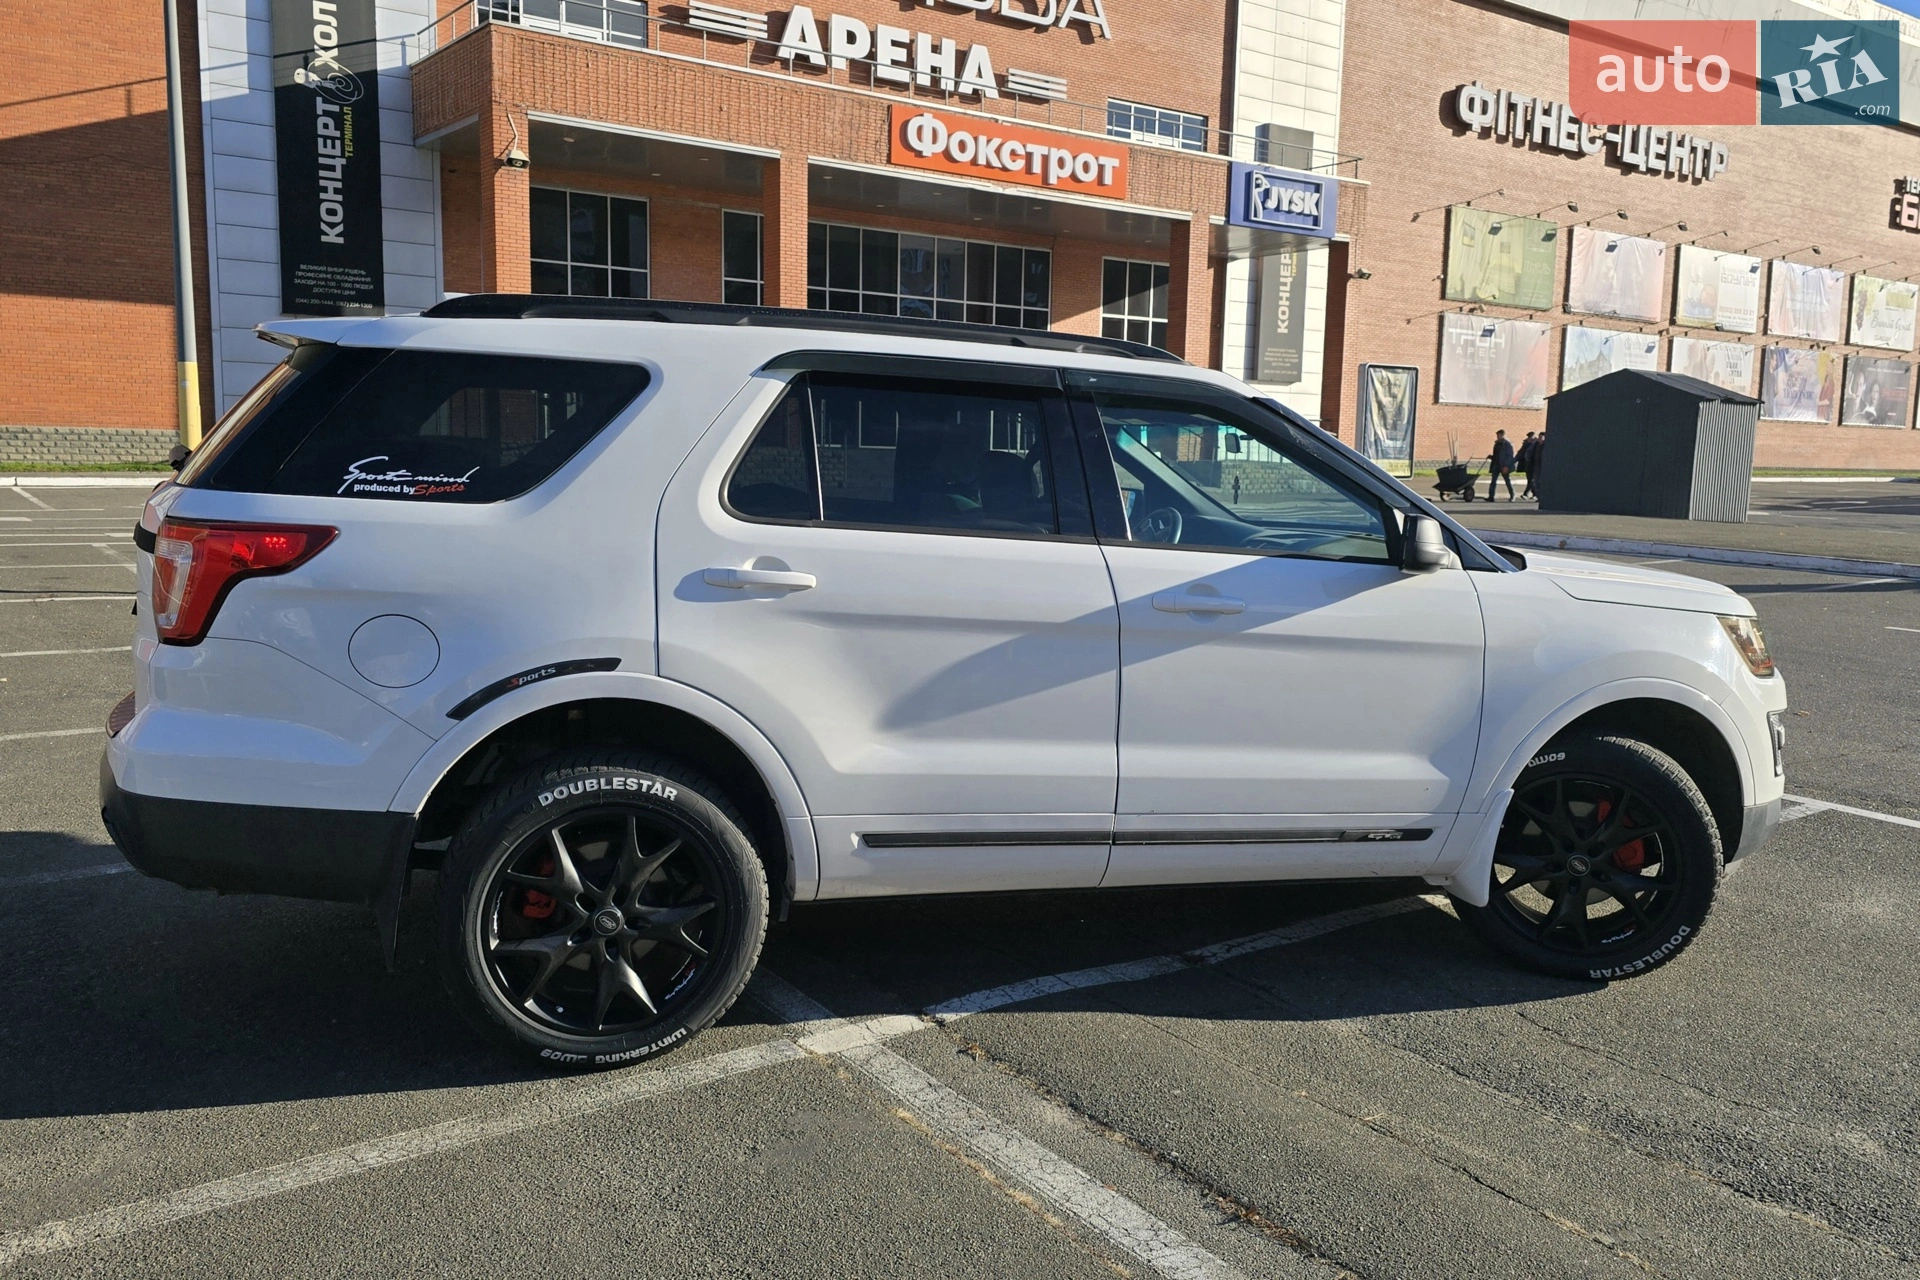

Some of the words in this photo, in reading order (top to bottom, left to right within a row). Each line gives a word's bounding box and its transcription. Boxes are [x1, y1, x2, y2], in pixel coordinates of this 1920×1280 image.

[312, 0, 339, 71] ХОЛ
[777, 4, 1000, 98] АРЕНА
[343, 106, 352, 158] ТЕРМІНАЛ
[906, 113, 1120, 187] Фокстрот
[1455, 80, 1730, 181] ФІТНЕС-ЦЕНТР
[316, 96, 346, 244] КОНЦЕРТ
[1266, 185, 1321, 217] JYSK
[1277, 250, 1293, 334] КОНЦЕР
[353, 483, 401, 493] produced
[402, 484, 416, 495] by
[413, 484, 466, 496] Sports
[506, 666, 557, 689] Sports
[537, 776, 679, 808] DOUBLESTAR
[1589, 925, 1692, 980] DOUBLESTAR
[594, 1027, 688, 1064] WINTERKING
